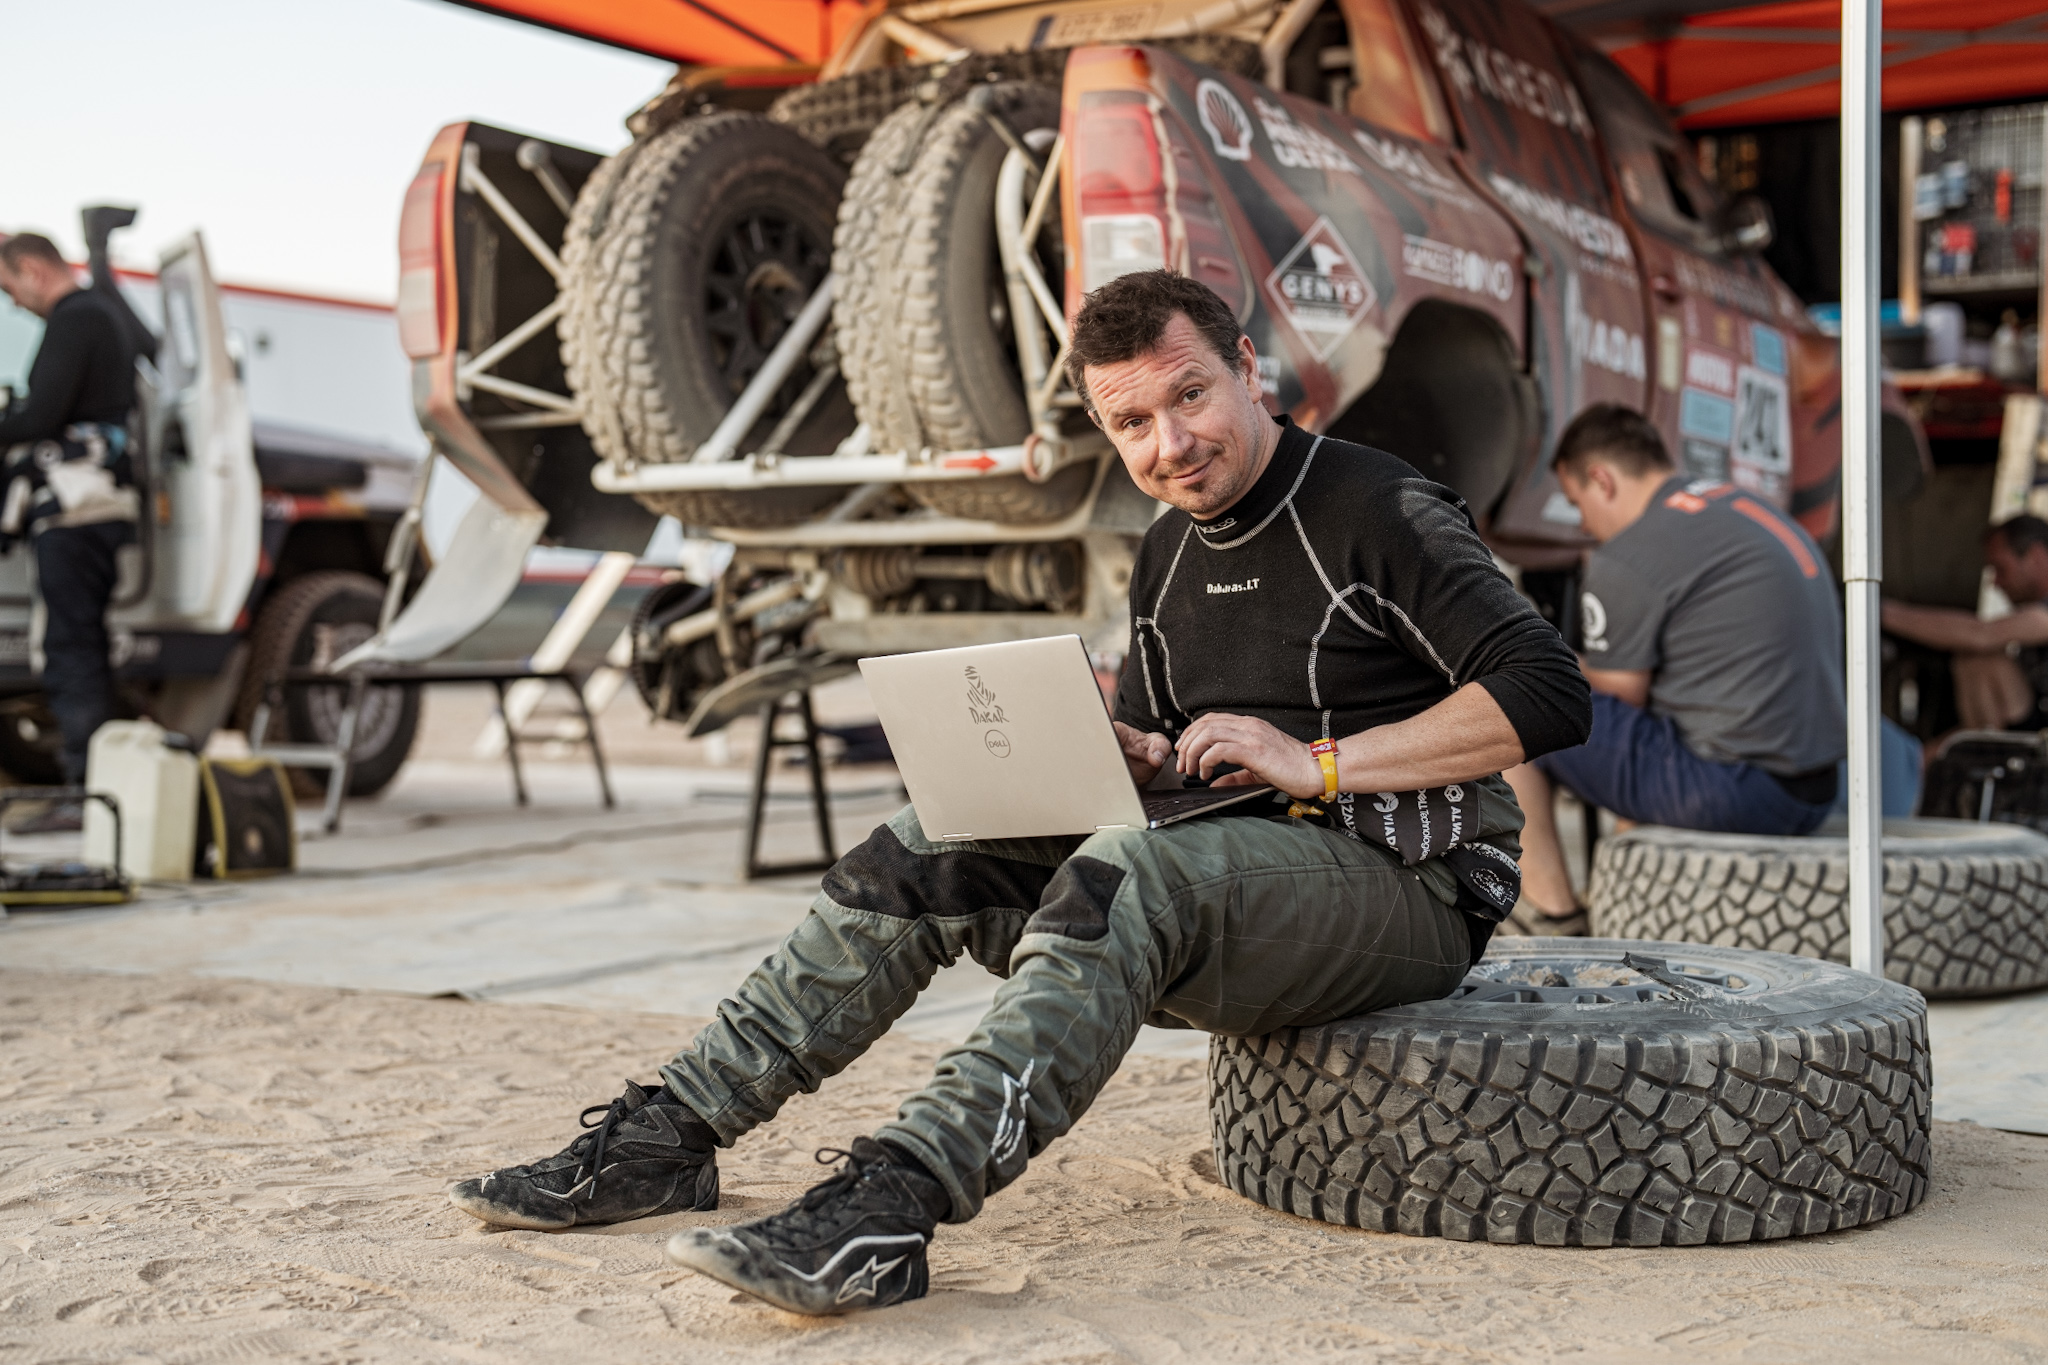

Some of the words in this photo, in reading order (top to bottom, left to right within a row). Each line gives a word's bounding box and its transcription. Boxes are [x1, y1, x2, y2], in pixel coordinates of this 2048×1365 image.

[1281, 273, 1363, 305] GENYS
[968, 705, 1010, 725] DAKAR
[988, 740, 1008, 748] DELL
[1341, 804, 1359, 833] ŽAL
